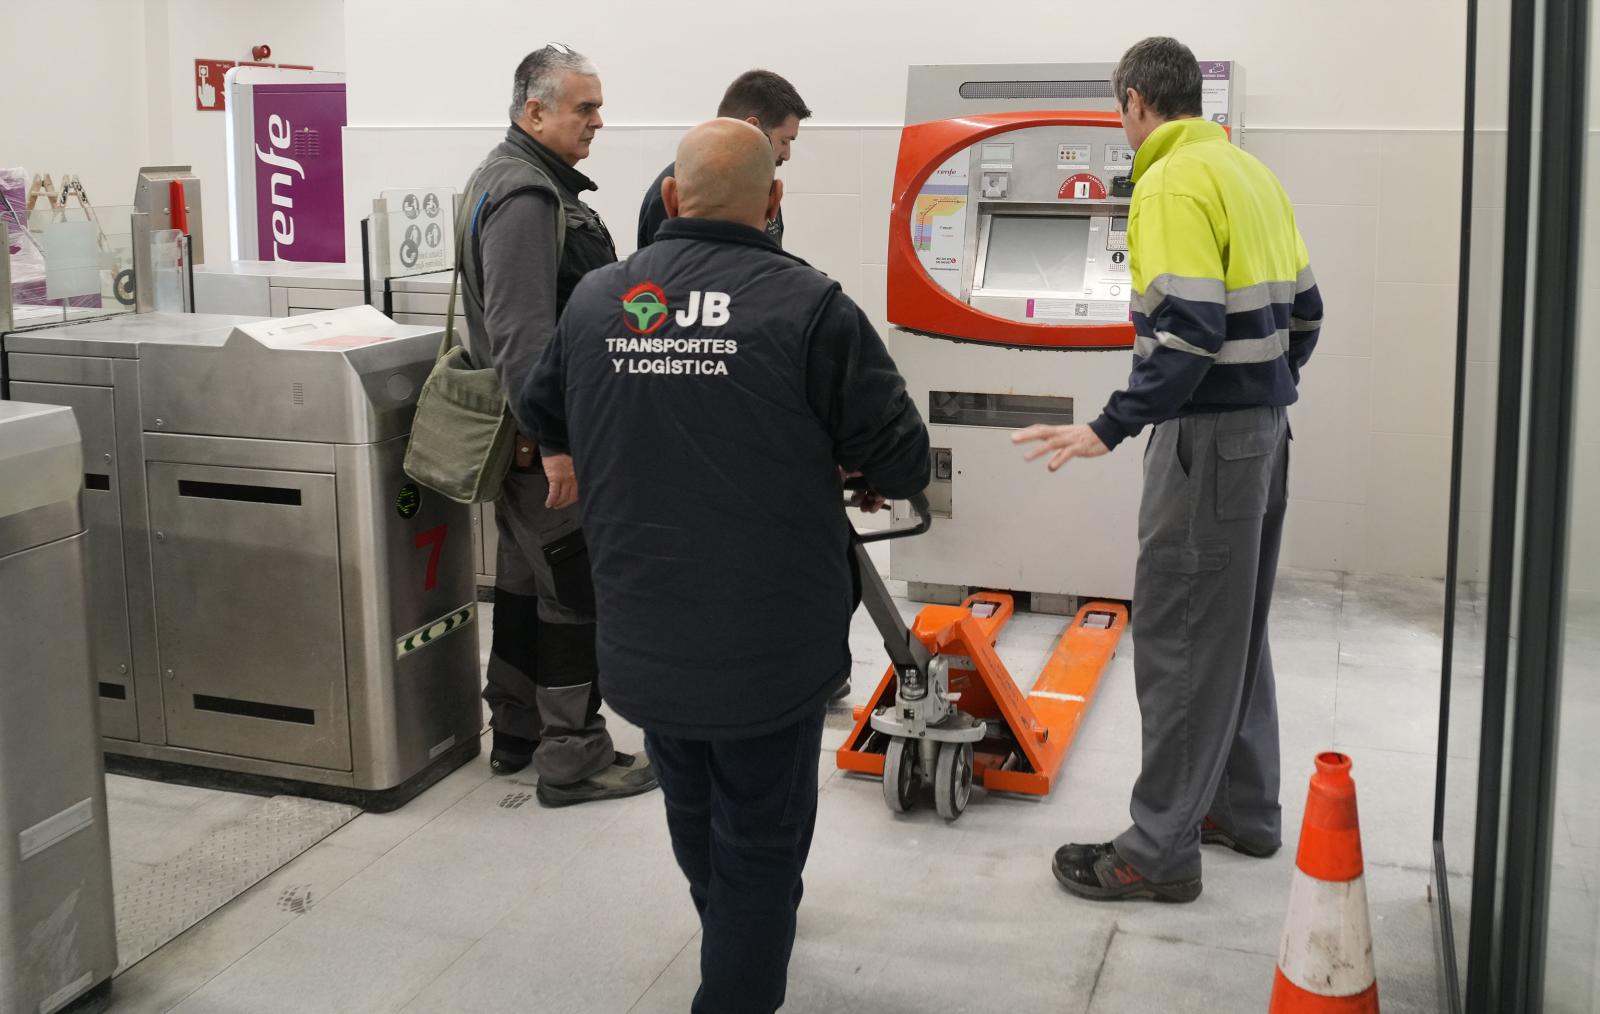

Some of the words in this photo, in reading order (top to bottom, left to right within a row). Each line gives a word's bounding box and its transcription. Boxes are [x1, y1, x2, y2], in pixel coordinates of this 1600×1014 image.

[937, 168, 957, 177] renfe
[675, 291, 731, 328] JB
[605, 338, 738, 354] TRANSPORTES
[612, 358, 624, 373] Y
[628, 356, 728, 375] LOGÍSTICA
[415, 524, 449, 592] 7
